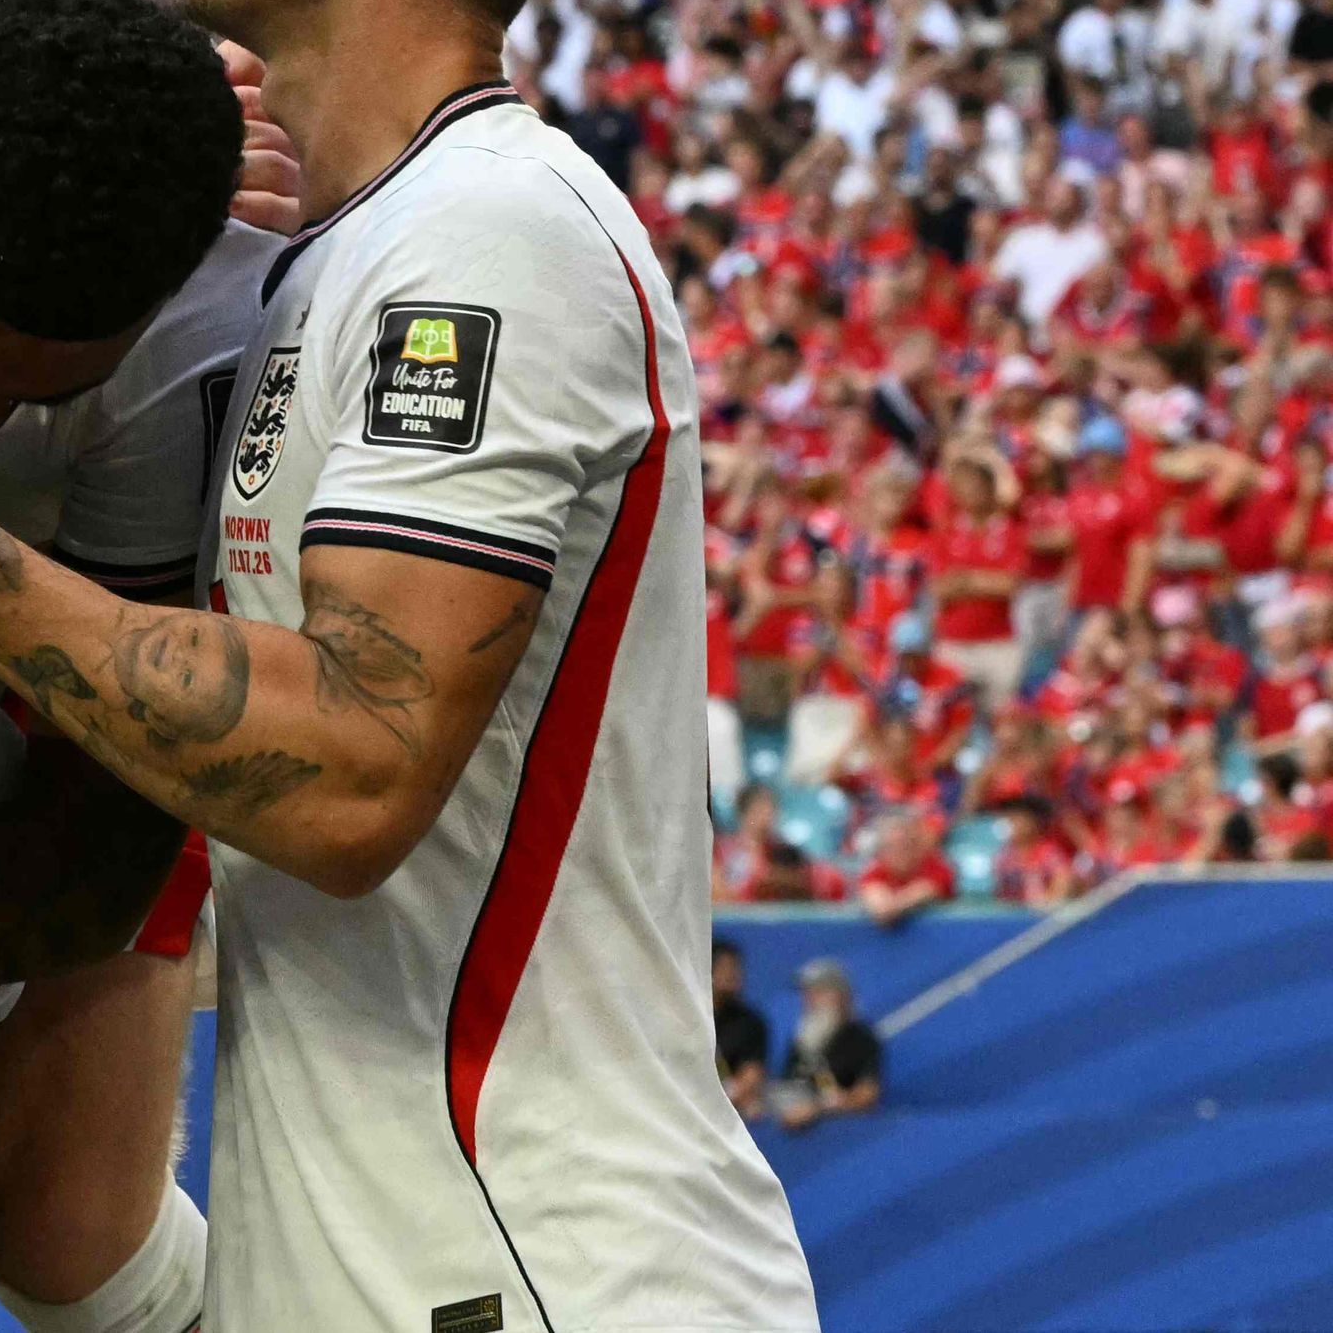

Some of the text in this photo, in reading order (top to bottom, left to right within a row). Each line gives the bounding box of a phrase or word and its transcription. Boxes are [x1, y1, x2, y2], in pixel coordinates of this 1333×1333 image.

[392, 363, 458, 391] Unite For
[381, 392, 466, 421] EDUCATION
[401, 418, 433, 433] FIFA
[224, 515, 271, 542] NORWAY
